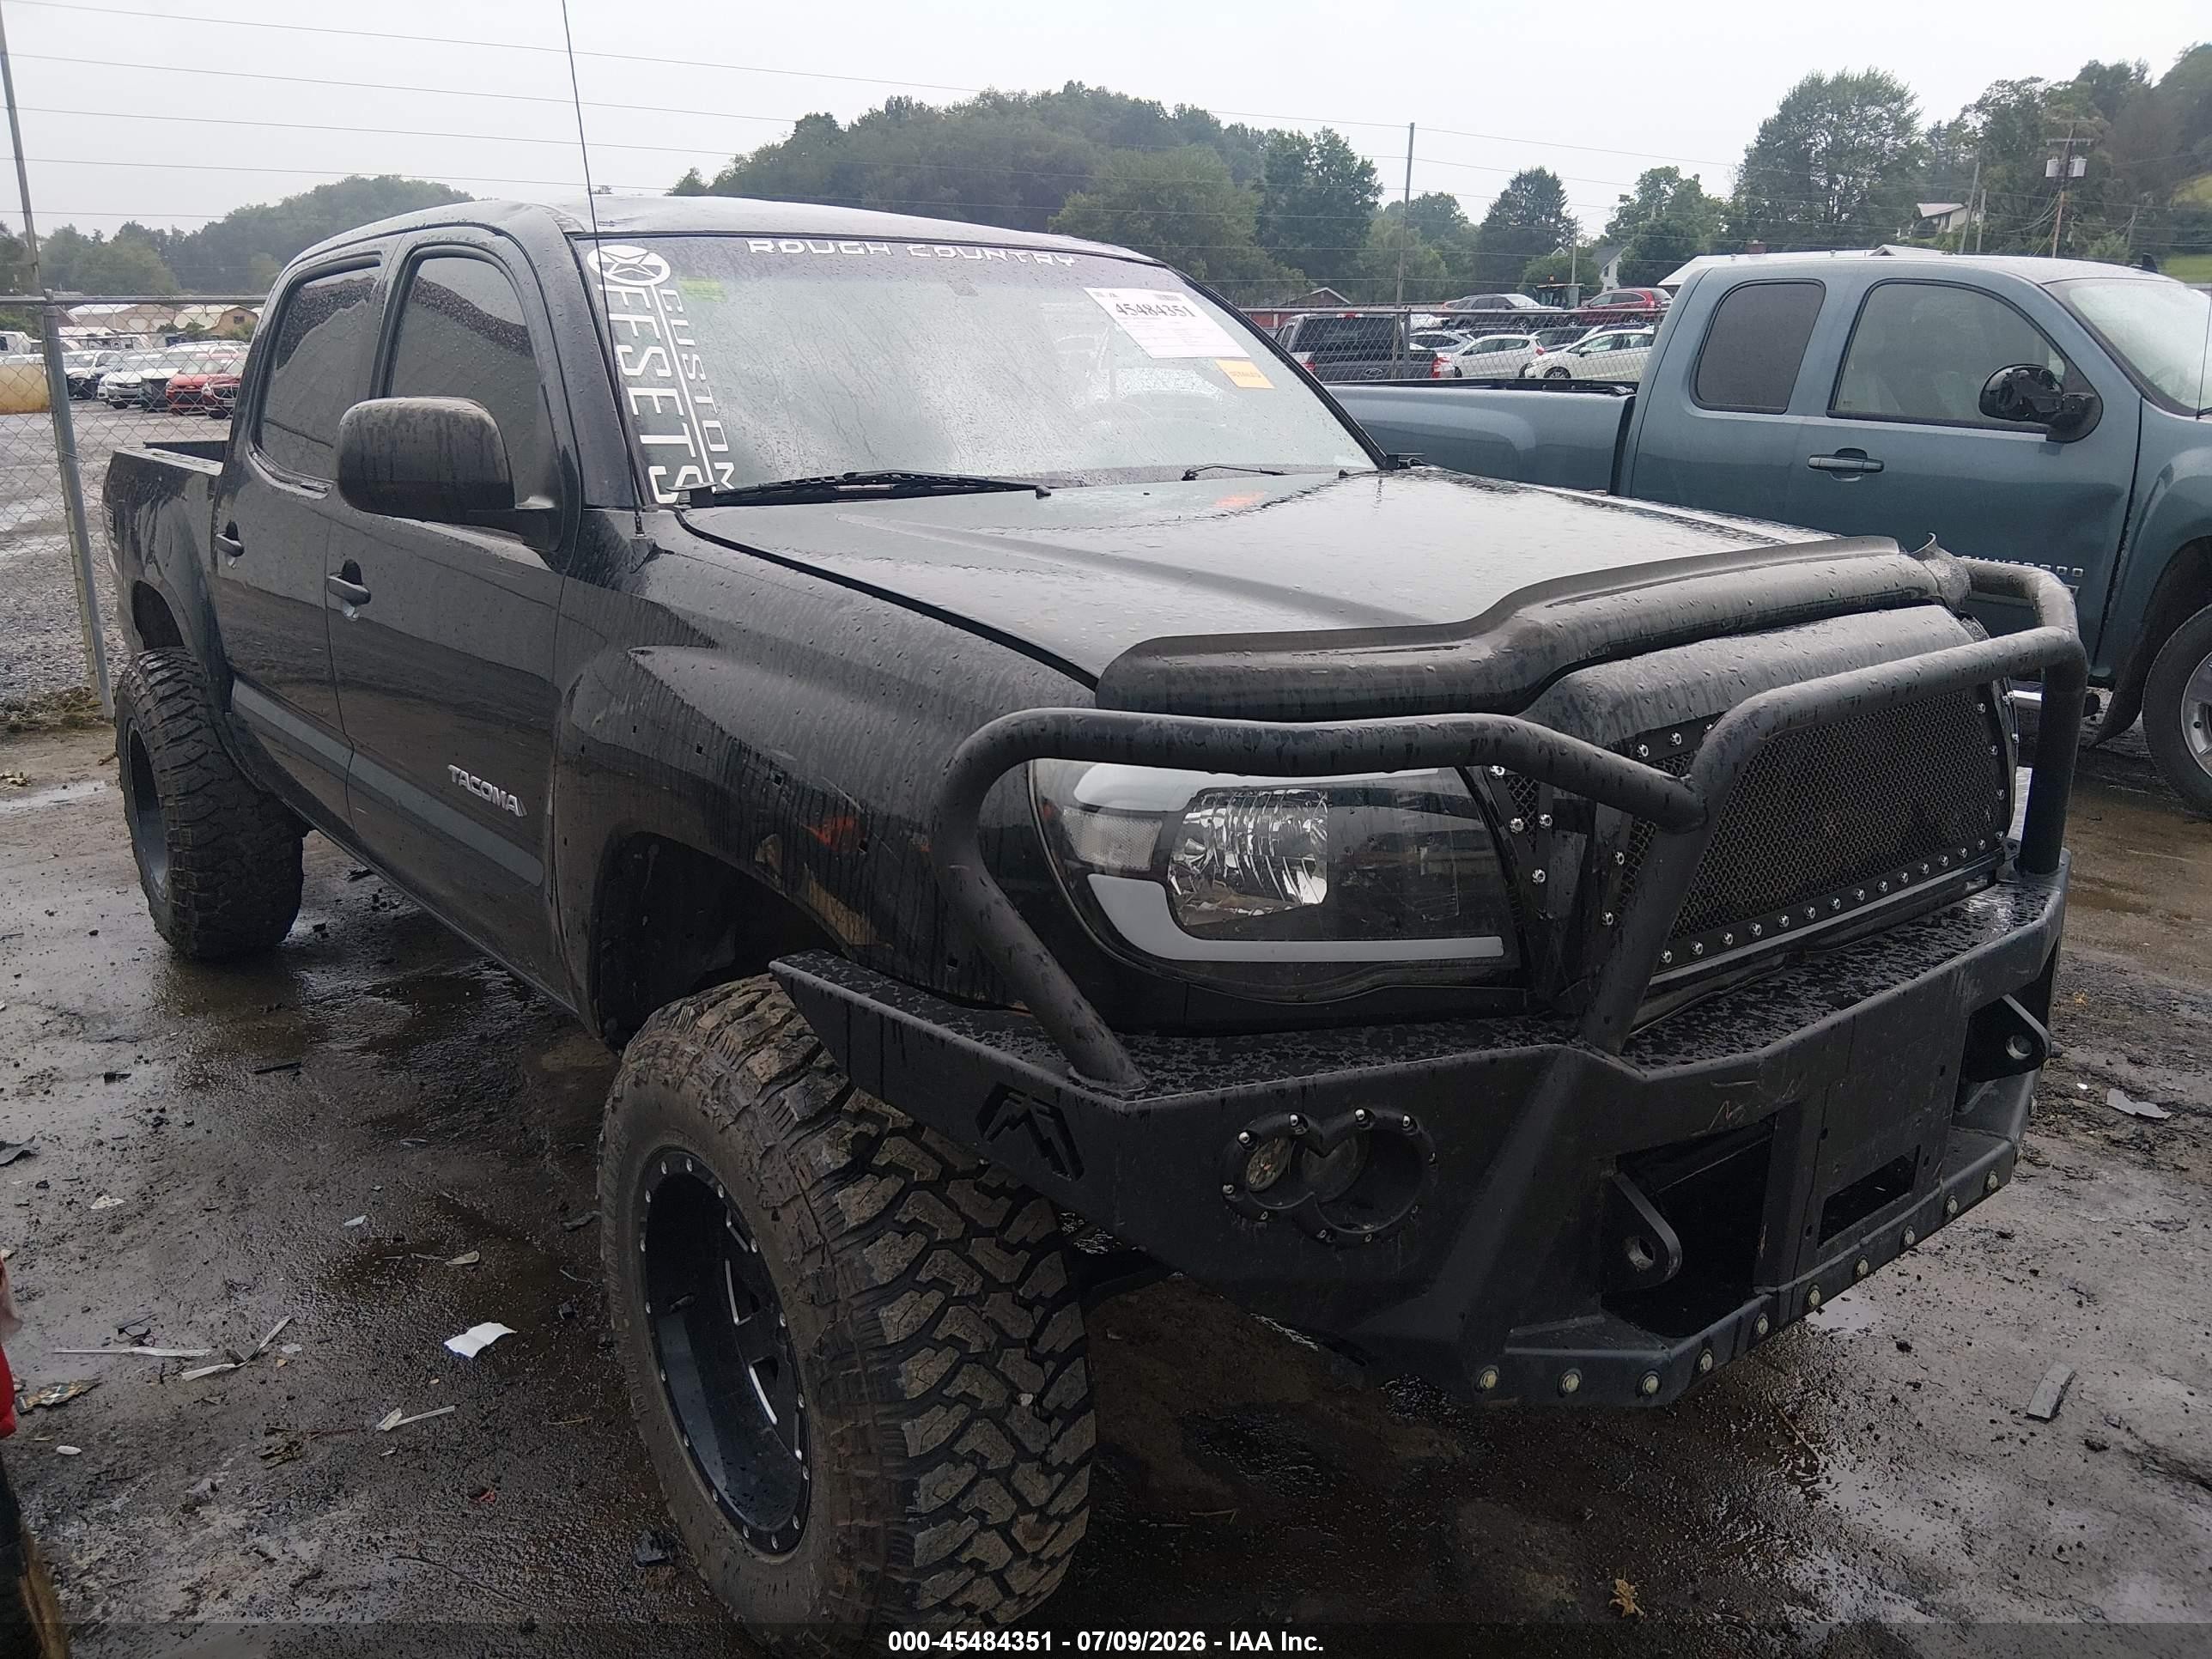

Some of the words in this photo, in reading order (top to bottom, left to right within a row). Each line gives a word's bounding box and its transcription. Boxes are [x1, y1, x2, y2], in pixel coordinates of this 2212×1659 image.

[744, 239, 894, 256] ROUGH
[906, 244, 1075, 267] COUNTRY
[1115, 302, 1198, 318] 45484351
[447, 764, 527, 817] TACOMA
